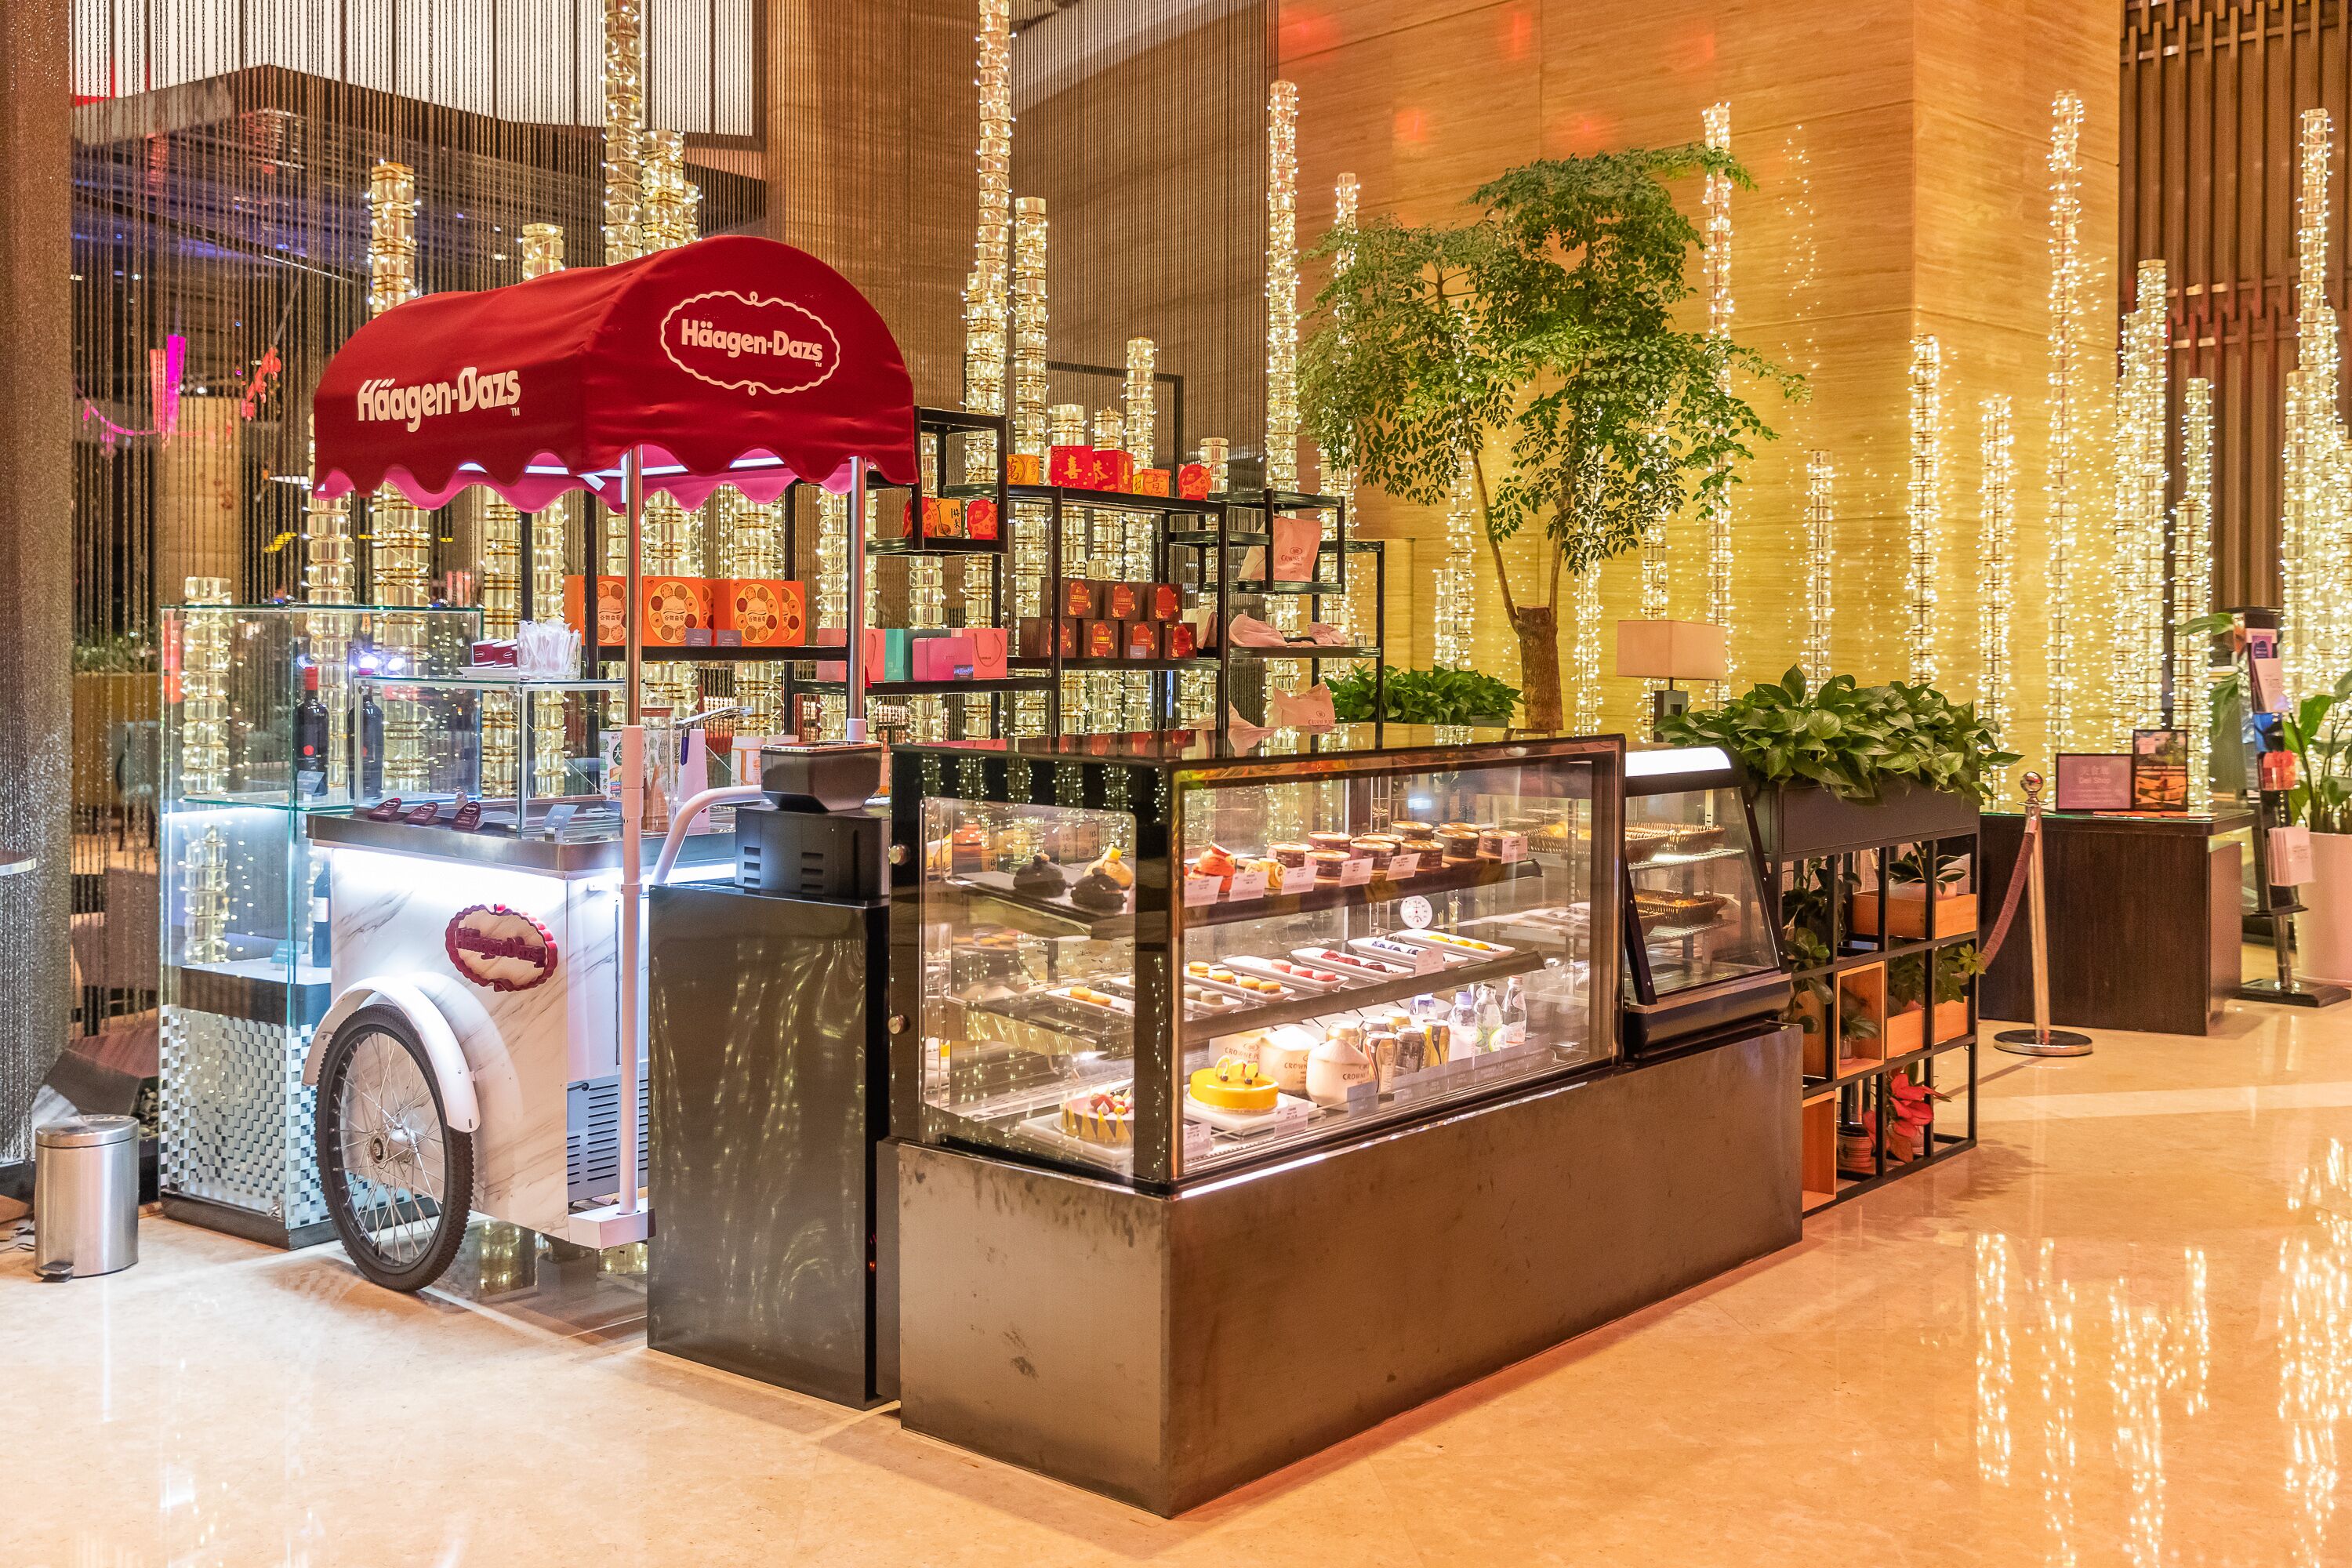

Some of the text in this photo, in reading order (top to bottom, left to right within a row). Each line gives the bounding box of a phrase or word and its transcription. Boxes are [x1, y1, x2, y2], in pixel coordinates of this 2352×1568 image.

[681, 318, 822, 361] Häagen-Dazs
[358, 366, 521, 432] Häagen-Dazs
[1063, 454, 1083, 480] 喜
[1225, 1047, 1252, 1059] CROWNE
